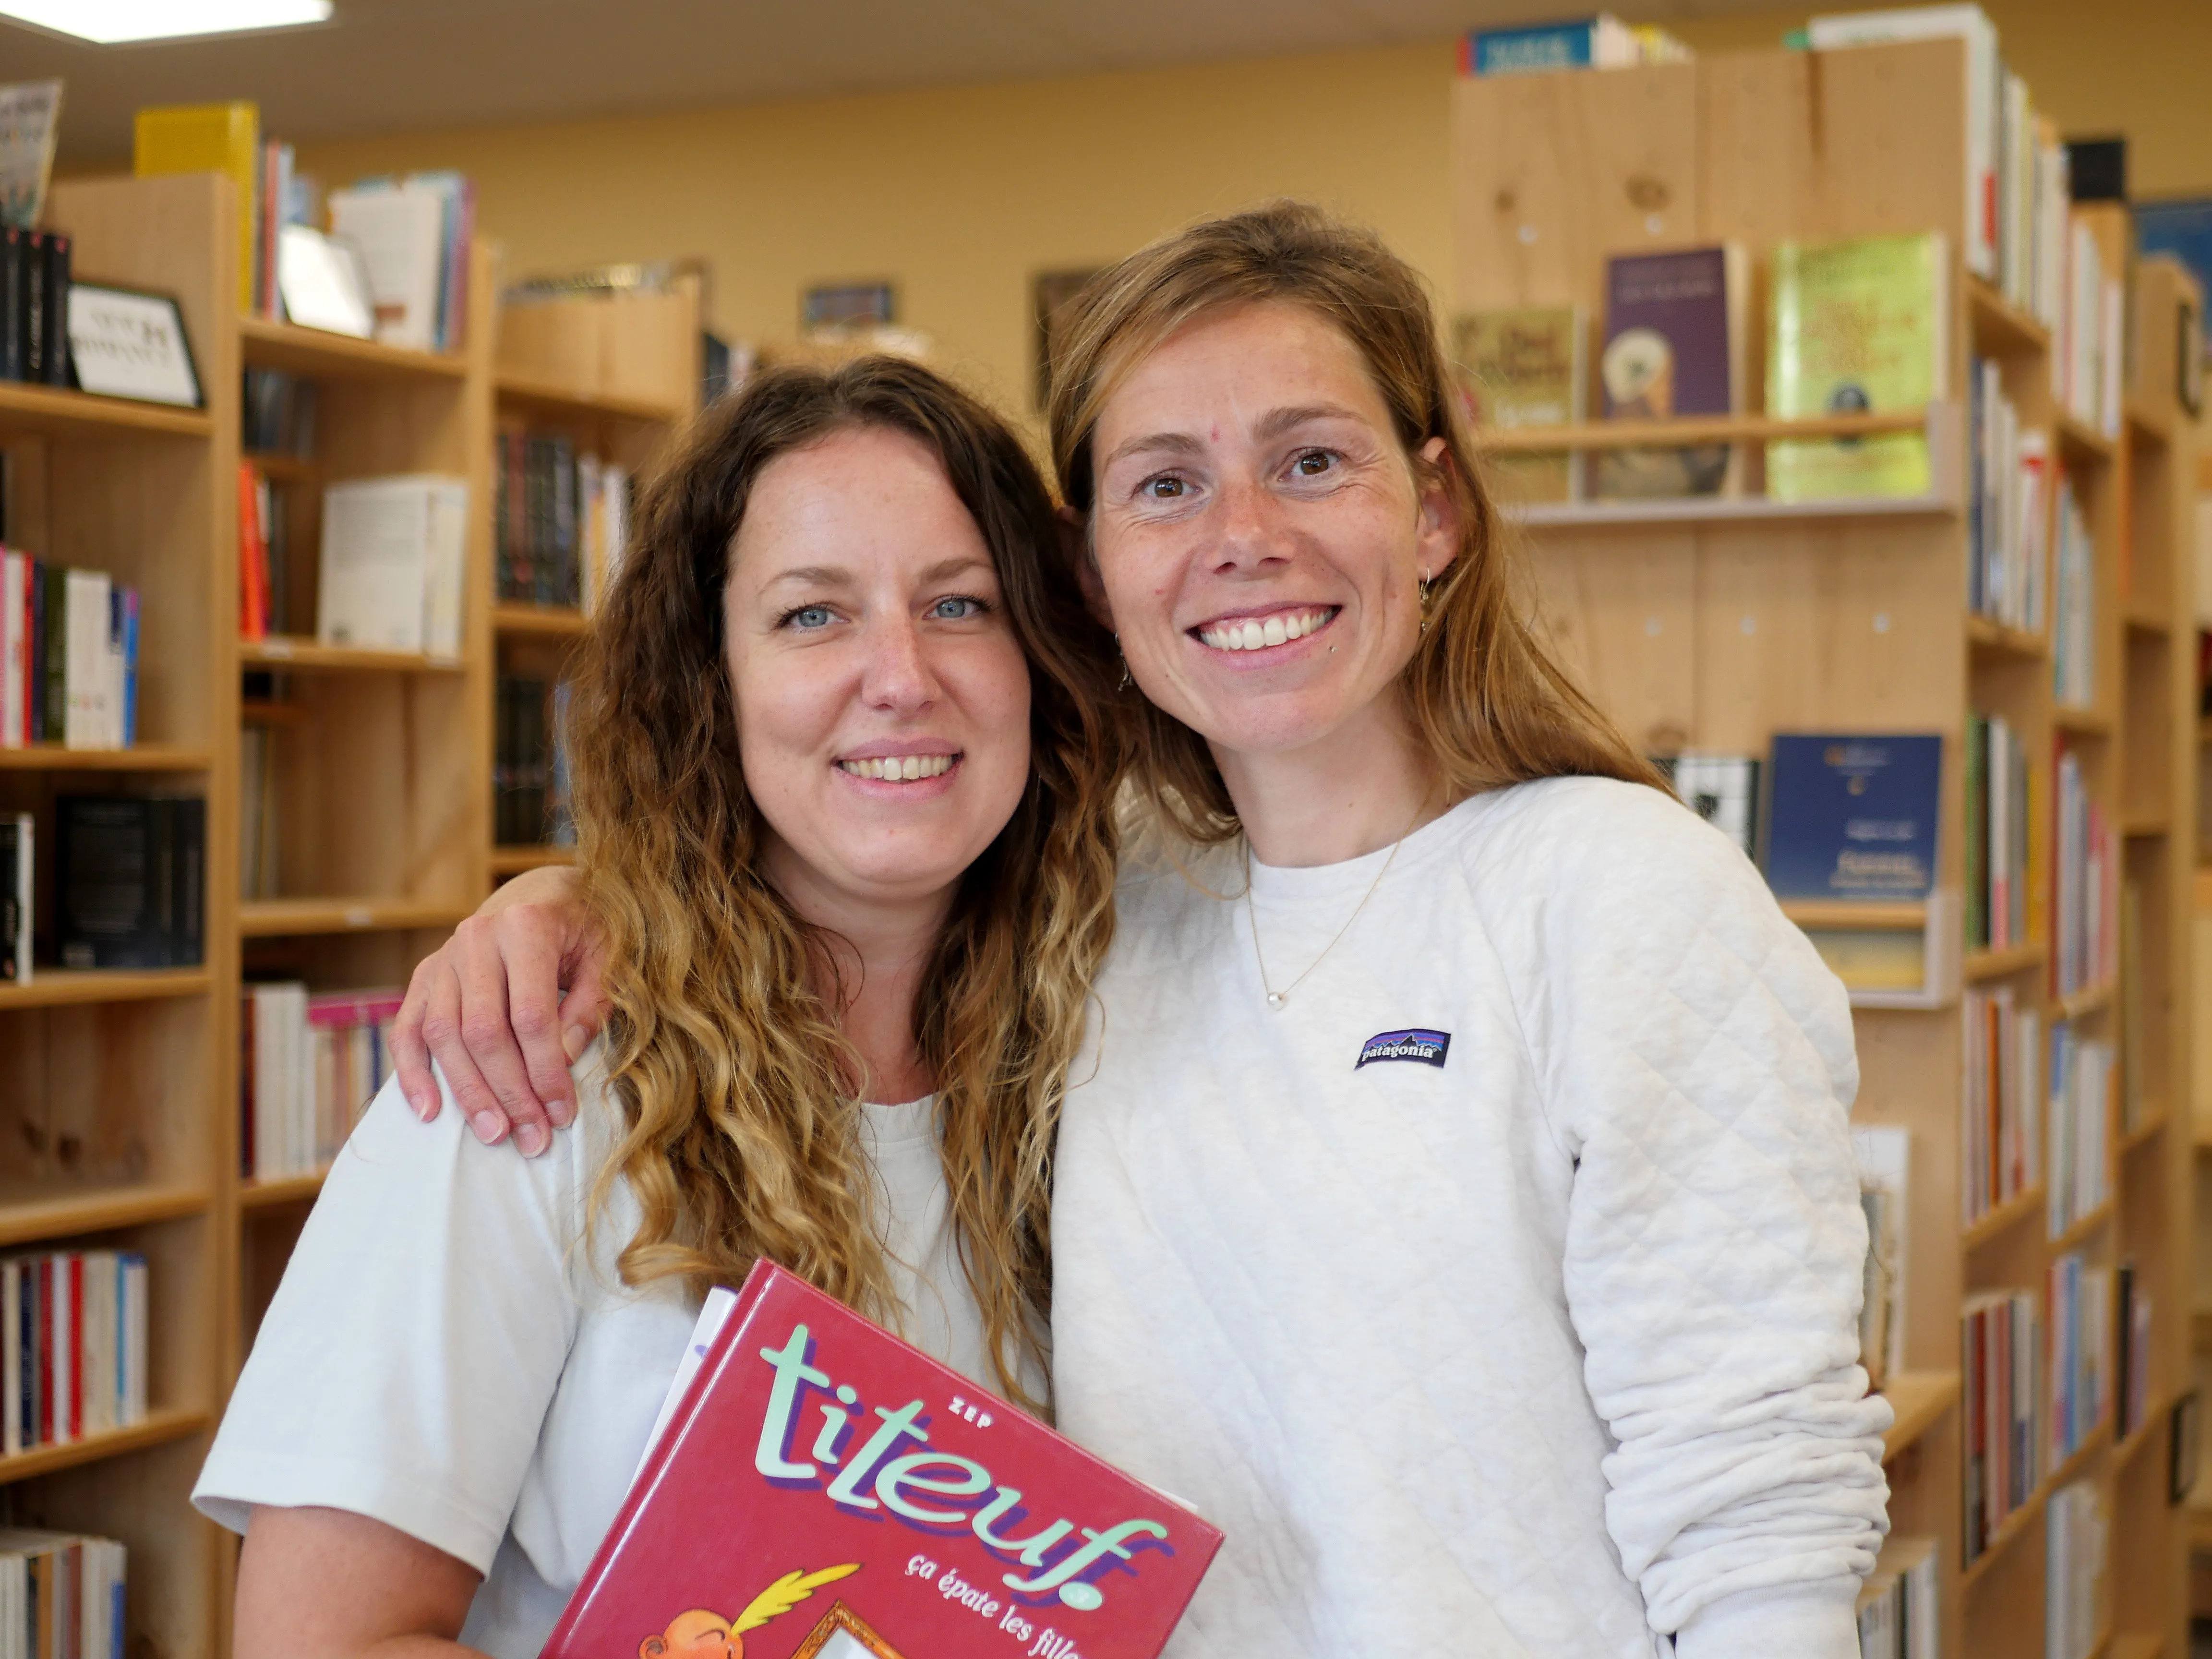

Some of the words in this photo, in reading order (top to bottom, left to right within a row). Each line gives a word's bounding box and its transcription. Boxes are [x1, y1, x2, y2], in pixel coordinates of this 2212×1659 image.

[948, 1396, 992, 1428] ZEP
[905, 1554, 936, 1579] ça
[938, 1568, 998, 1618] épate
[998, 1604, 1033, 1641] les
